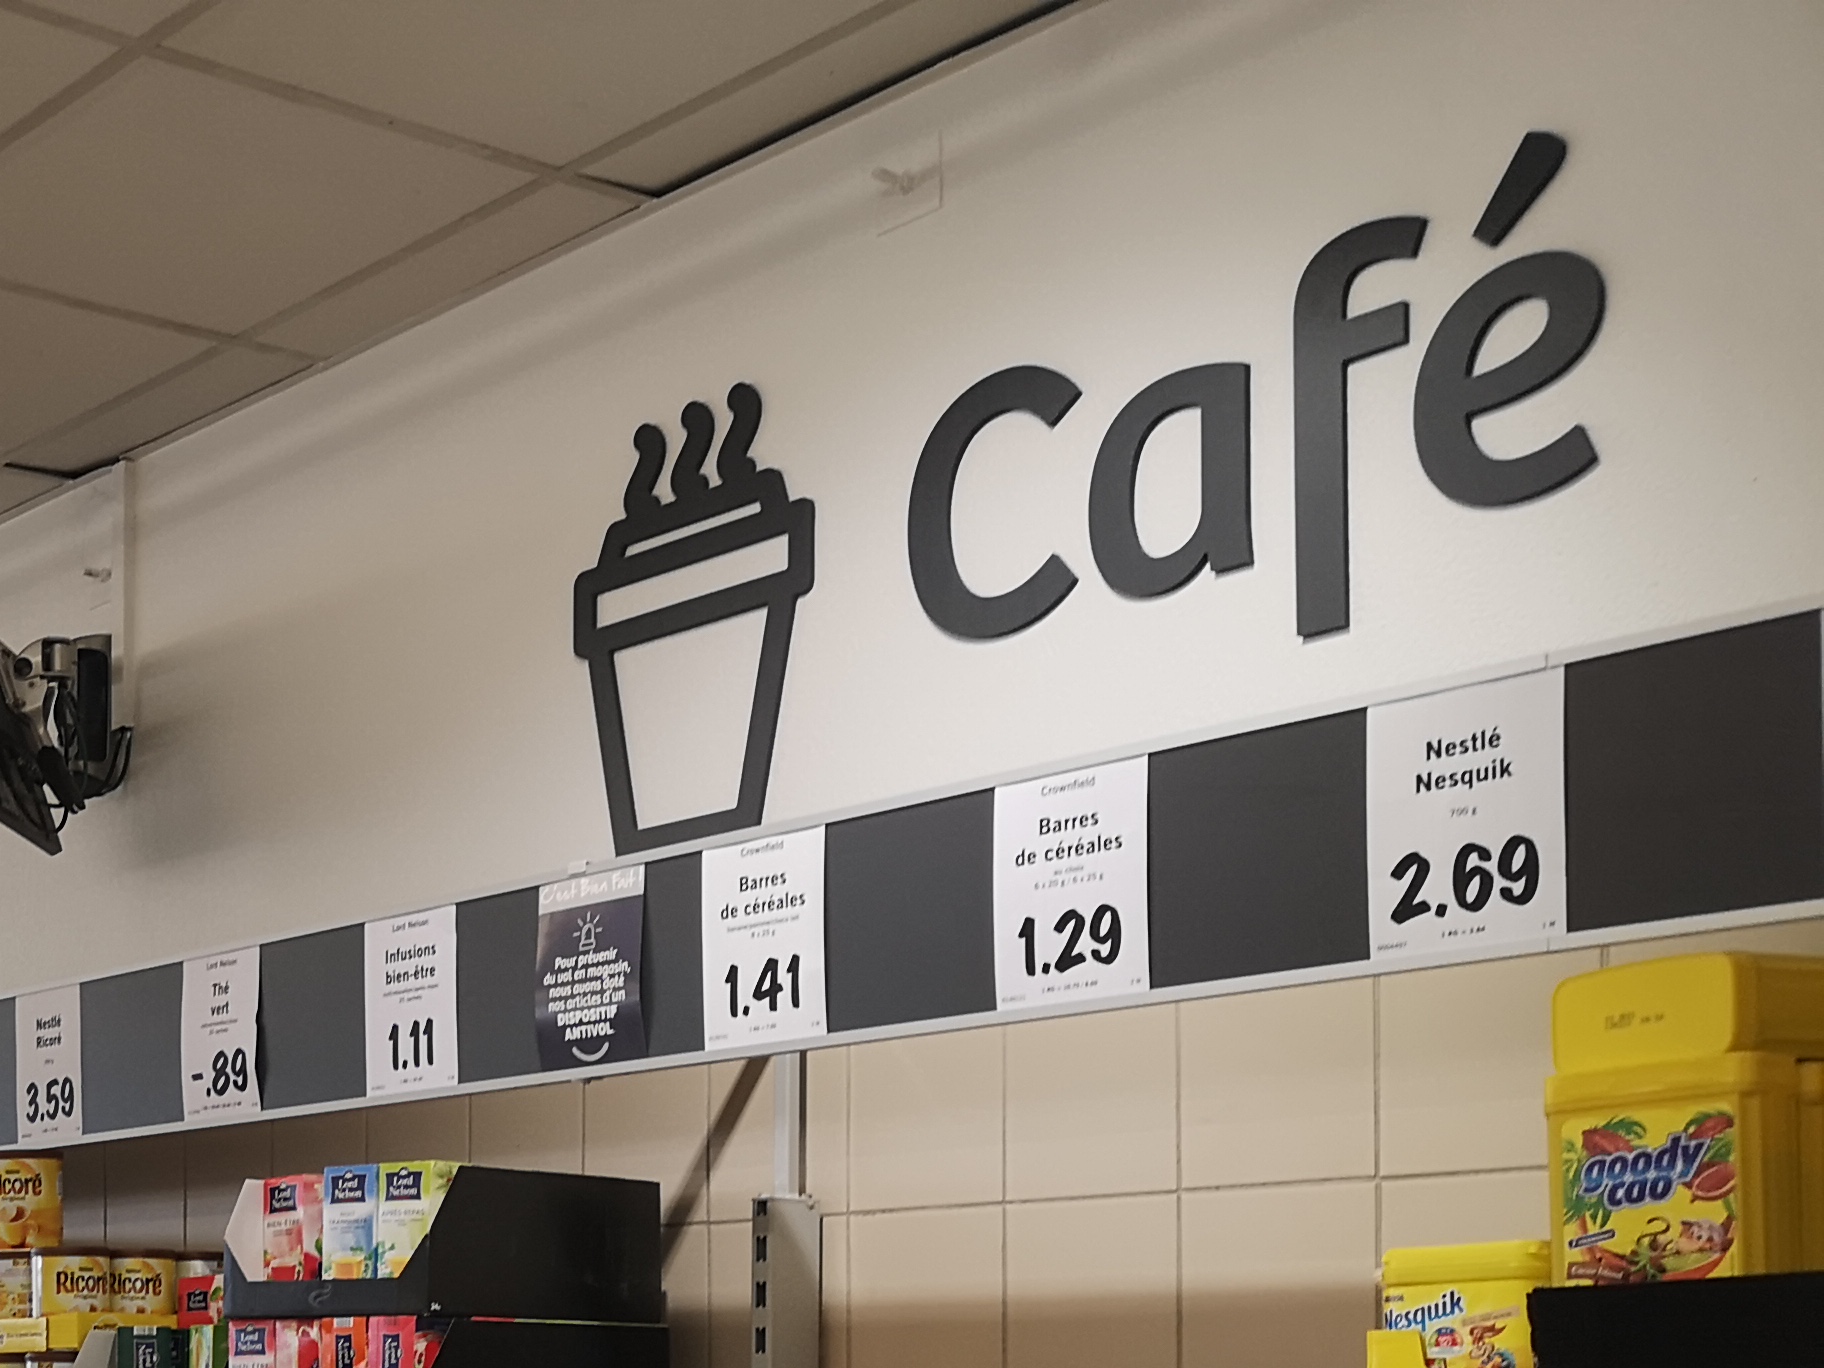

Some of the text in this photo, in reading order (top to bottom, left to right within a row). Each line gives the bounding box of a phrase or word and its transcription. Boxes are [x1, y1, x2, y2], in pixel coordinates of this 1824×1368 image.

[906, 129, 1608, 644] Café
[1425, 725, 1502, 761] Nestlé
[1041, 776, 1096, 797] Crownfield
[1415, 757, 1513, 794] Nesquik
[1039, 811, 1099, 836] Barres
[1015, 834, 1123, 867] de céréales
[739, 871, 787, 892] Barres
[1389, 833, 1540, 925] 2.69
[720, 891, 806, 920] de céréales
[1017, 903, 1122, 977] 1.29
[385, 943, 437, 965] Infusions
[555, 946, 618, 970] Pour prévenir
[385, 964, 436, 986] bien-être
[543, 971, 556, 986] du
[558, 968, 572, 983] vol
[574, 967, 586, 980] en
[724, 953, 800, 1018] 1.41
[212, 980, 230, 998] Thé
[549, 984, 571, 998] nous
[210, 1001, 230, 1017] vert
[548, 998, 565, 1013] nos
[566, 992, 601, 1010] articles
[36, 1014, 62, 1032] Nestlé
[557, 1005, 619, 1027] DISPOSITIF
[36, 1031, 62, 1050] Ricoré
[564, 1020, 615, 1041] ANTIVOL
[388, 1017, 434, 1071] 1.11
[26, 1076, 75, 1123] 3.59
[1578, 1131, 1712, 1197] goody
[338, 1177, 358, 1189] Lord
[389, 1184, 418, 1198] Nelson
[393, 1175, 414, 1187] Lord
[334, 1187, 362, 1200] Nelson
[1604, 1175, 1674, 1212] cao
